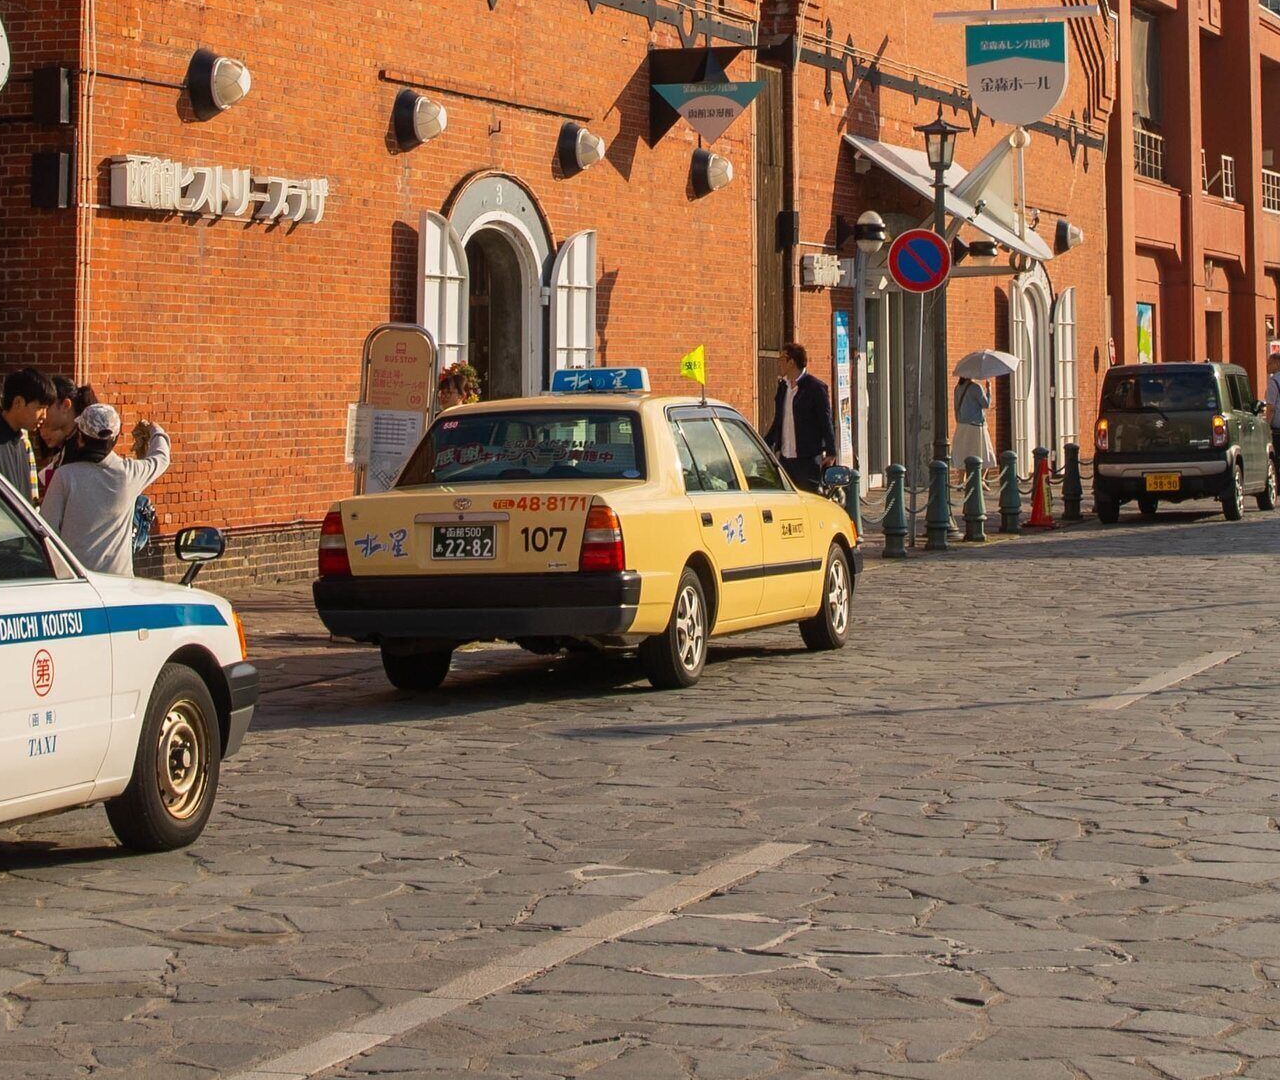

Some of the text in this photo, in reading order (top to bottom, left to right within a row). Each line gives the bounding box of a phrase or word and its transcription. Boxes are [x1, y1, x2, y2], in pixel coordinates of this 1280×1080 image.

[980, 76, 1051, 92] 金森ホール
[111, 154, 328, 224] 函館ヒストリープラザ
[496, 183, 504, 206] 3
[384, 355, 417, 364] BUS STOP
[564, 370, 628, 390] 北の星
[410, 395, 421, 405] 09
[494, 496, 587, 512] TEL 48-8171
[354, 528, 408, 558] 北の星
[445, 539, 492, 557] 22-82
[520, 526, 568, 554] 107
[41, 612, 83, 637] KOUTSU
[36, 658, 51, 689] 第一
[28, 735, 58, 758] TAXI
